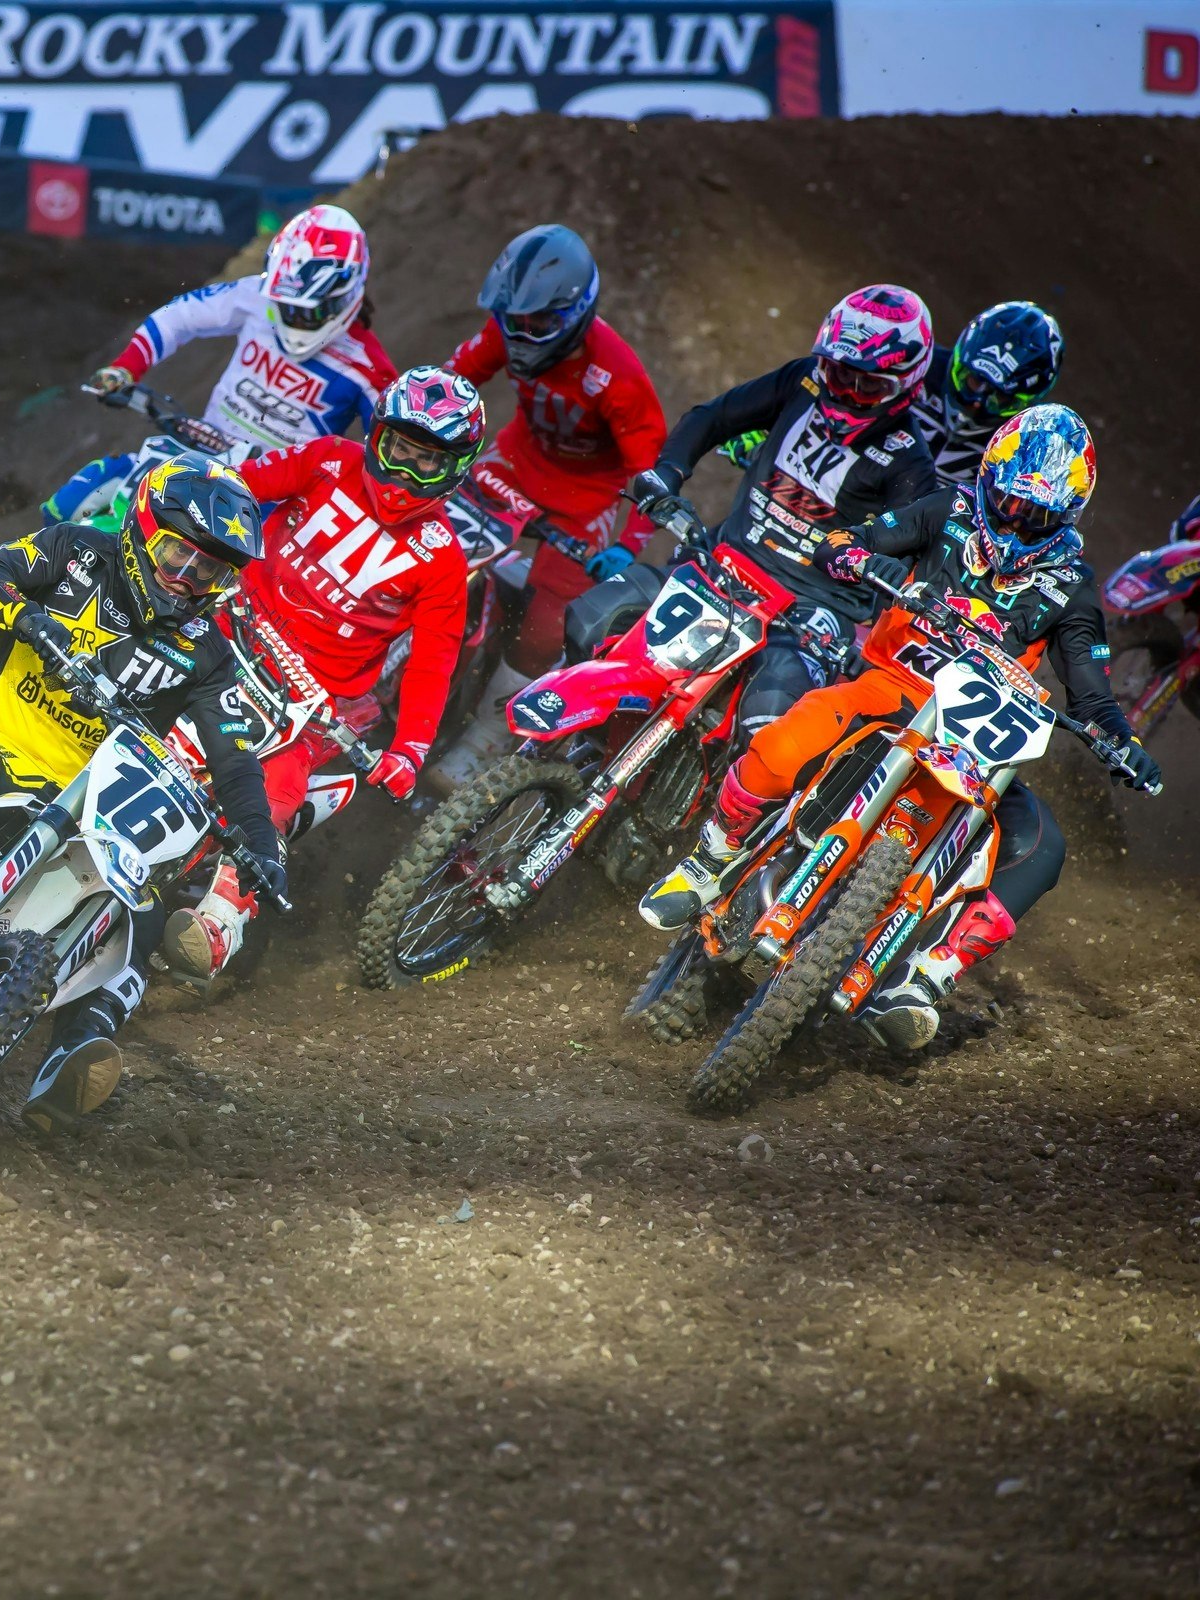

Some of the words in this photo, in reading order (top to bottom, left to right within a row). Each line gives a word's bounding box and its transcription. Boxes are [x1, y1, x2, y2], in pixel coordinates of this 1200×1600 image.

[262, 3, 769, 77] MOUNTAIN
[93, 188, 225, 236] TOYOTA
[409, 411, 435, 426] SHOEI
[531, 383, 585, 436] LY
[1012, 480, 1034, 494] Red
[1032, 484, 1055, 502] Bull
[293, 486, 419, 600] FLY
[766, 503, 793, 528] LUCAS
[791, 519, 810, 535] OIL
[279, 541, 358, 614] RACING
[116, 647, 188, 695] FLY
[153, 640, 193, 668] MOTOREX
[37, 692, 108, 743] Husqva
[241, 673, 273, 712] MONSTER
[942, 680, 1041, 763] 25
[152, 760, 186, 800] MTER
[97, 761, 186, 855] 16
[534, 837, 576, 888] VERTEX
[885, 911, 921, 963] MOTOREX
